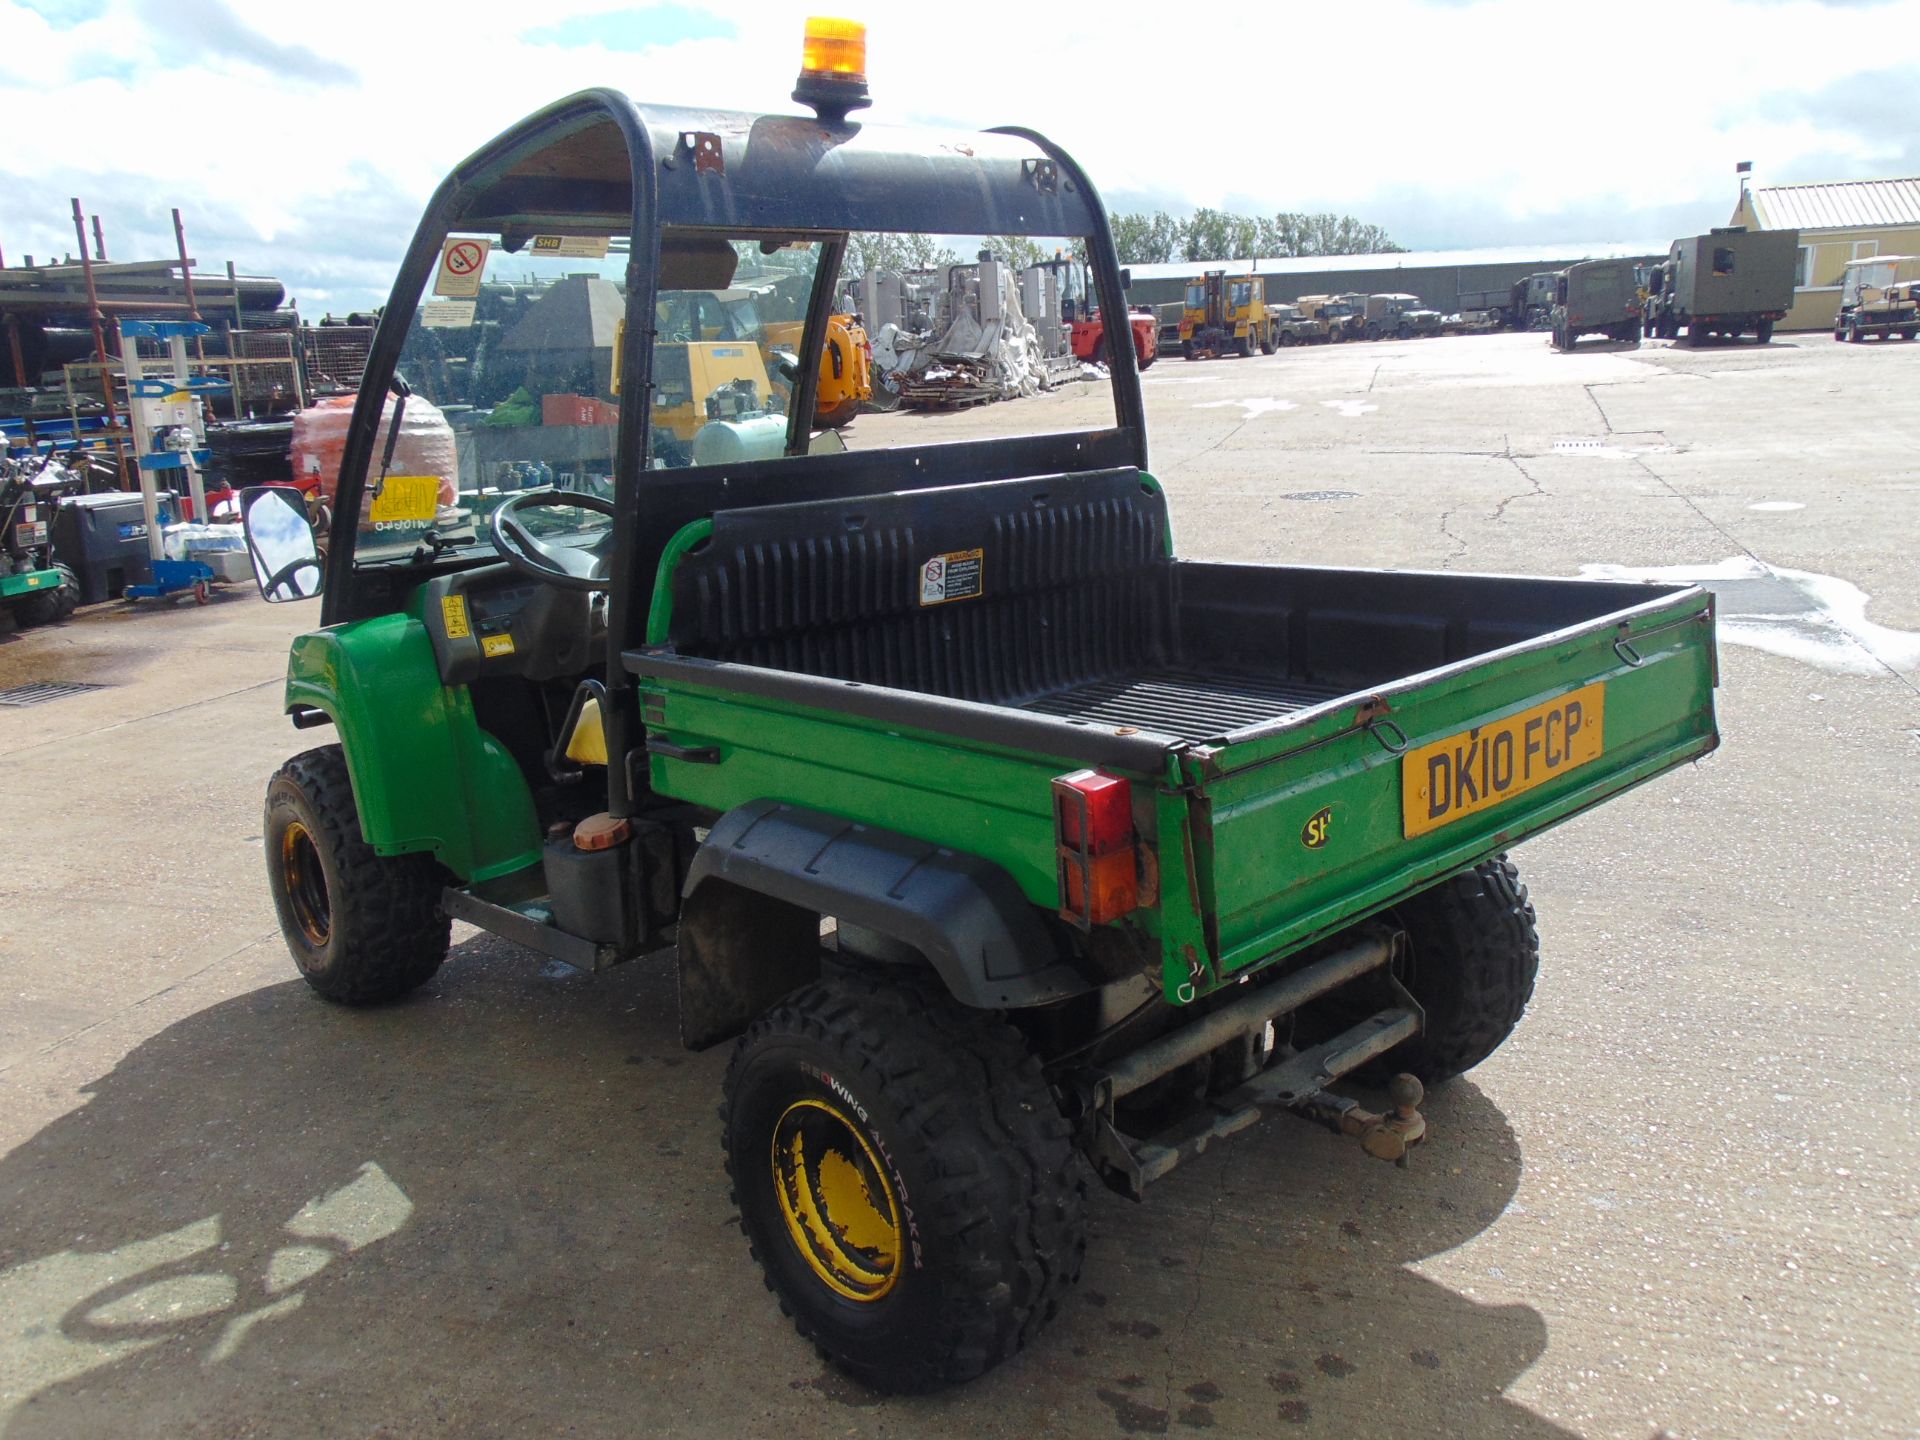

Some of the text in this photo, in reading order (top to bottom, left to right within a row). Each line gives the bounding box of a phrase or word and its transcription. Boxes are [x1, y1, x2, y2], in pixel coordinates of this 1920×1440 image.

[536, 238, 559, 247] SHB
[1428, 701, 1582, 820] DK10 FCP
[799, 1060, 869, 1123] REDWING
[870, 1128, 892, 1169] ALL
